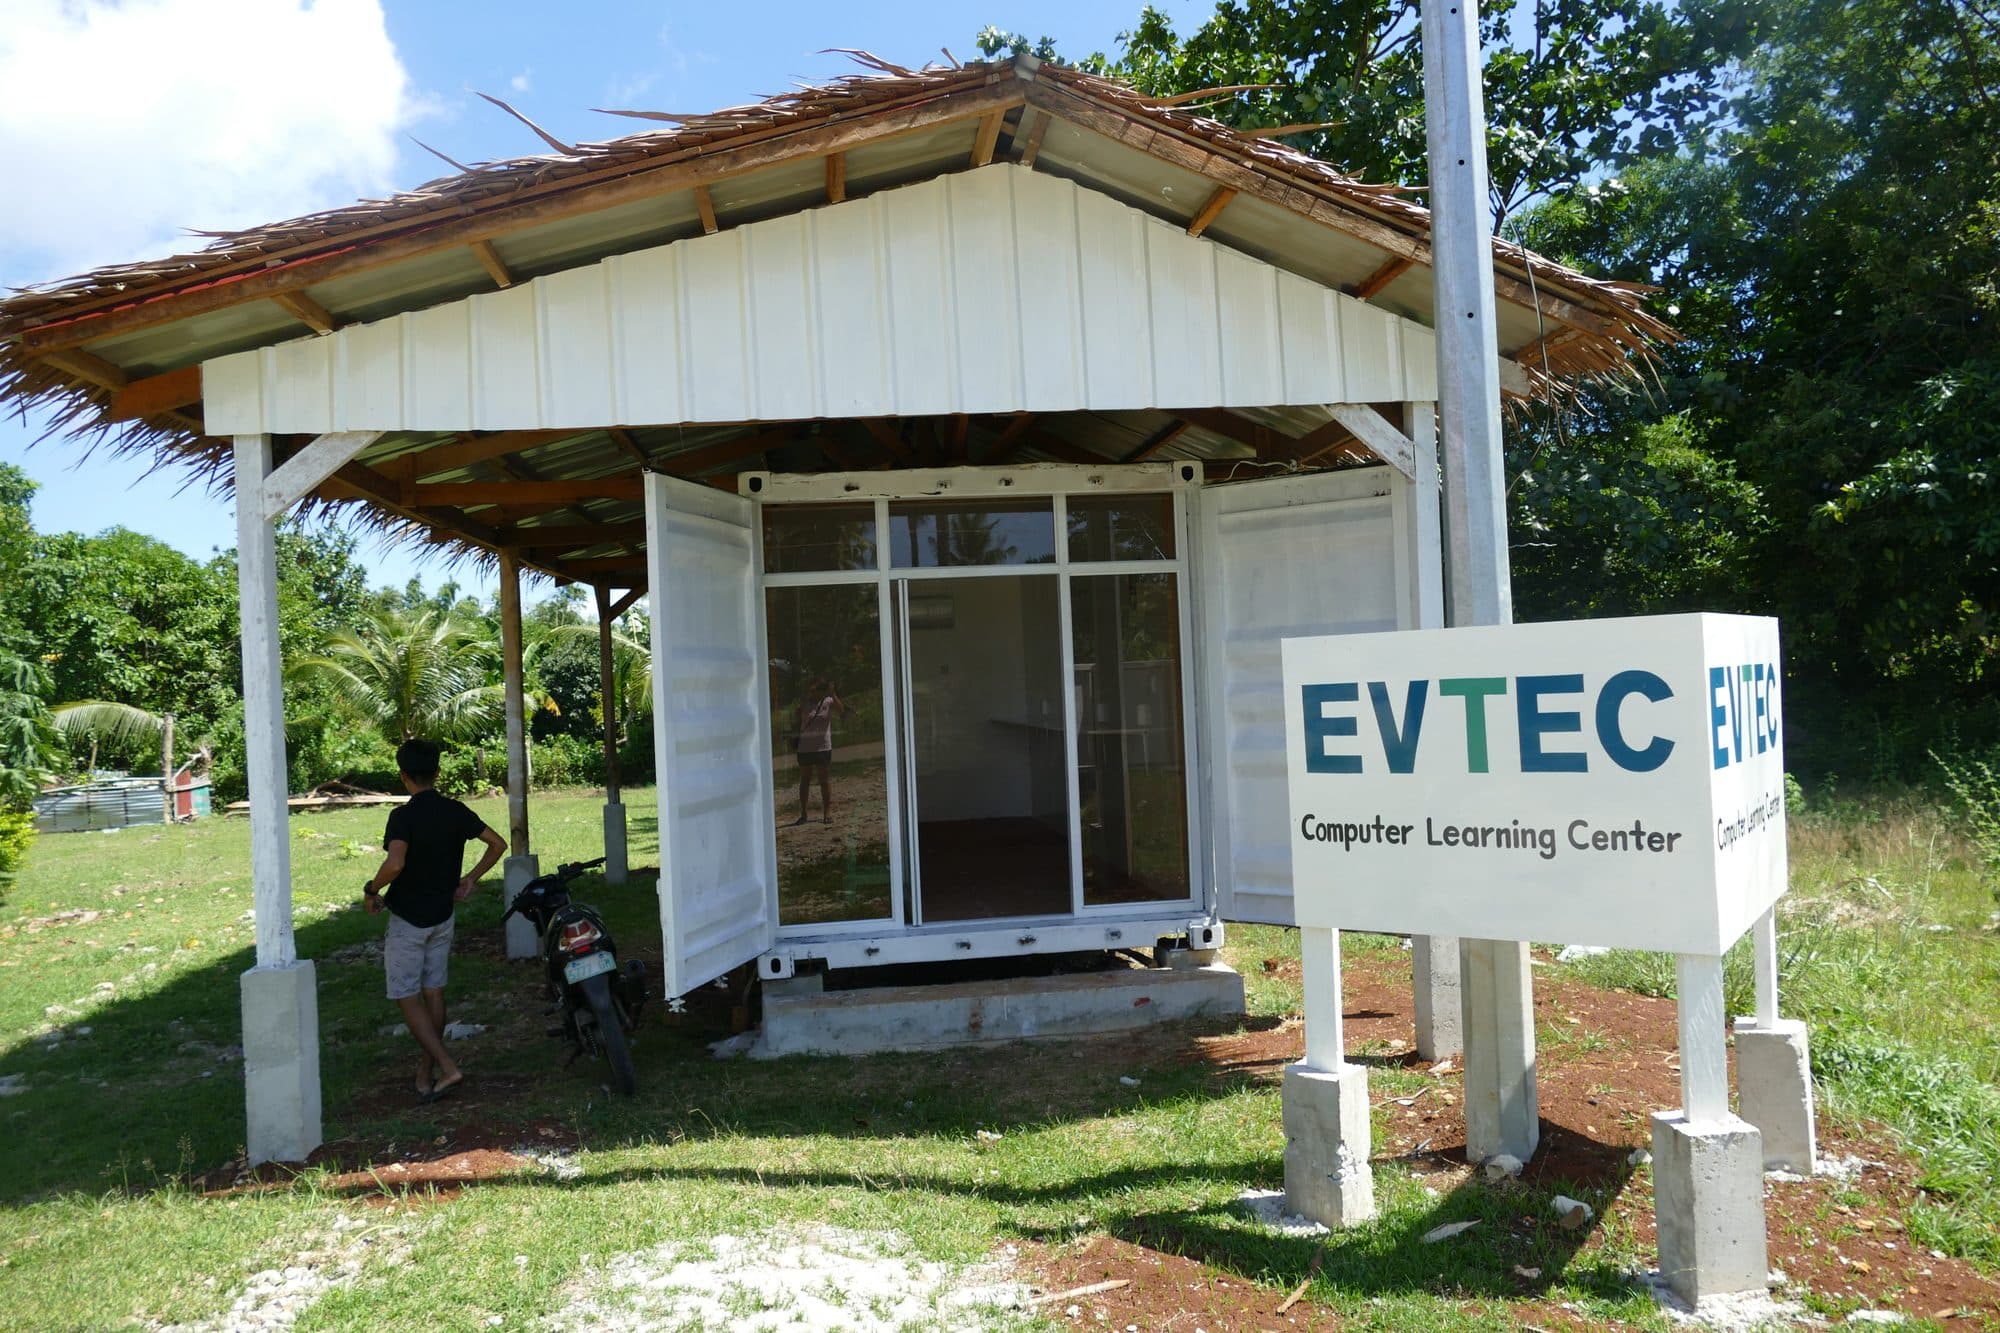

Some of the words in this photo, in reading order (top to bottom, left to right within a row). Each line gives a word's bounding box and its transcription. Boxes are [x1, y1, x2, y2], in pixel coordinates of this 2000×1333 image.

[1301, 669, 1675, 774] EVTEC
[1708, 662, 1778, 771] EVTEC
[1301, 813, 1414, 852] Computer
[1426, 816, 1557, 860] Learning
[1567, 819, 1682, 853] Center
[1717, 808, 1746, 853] Computer
